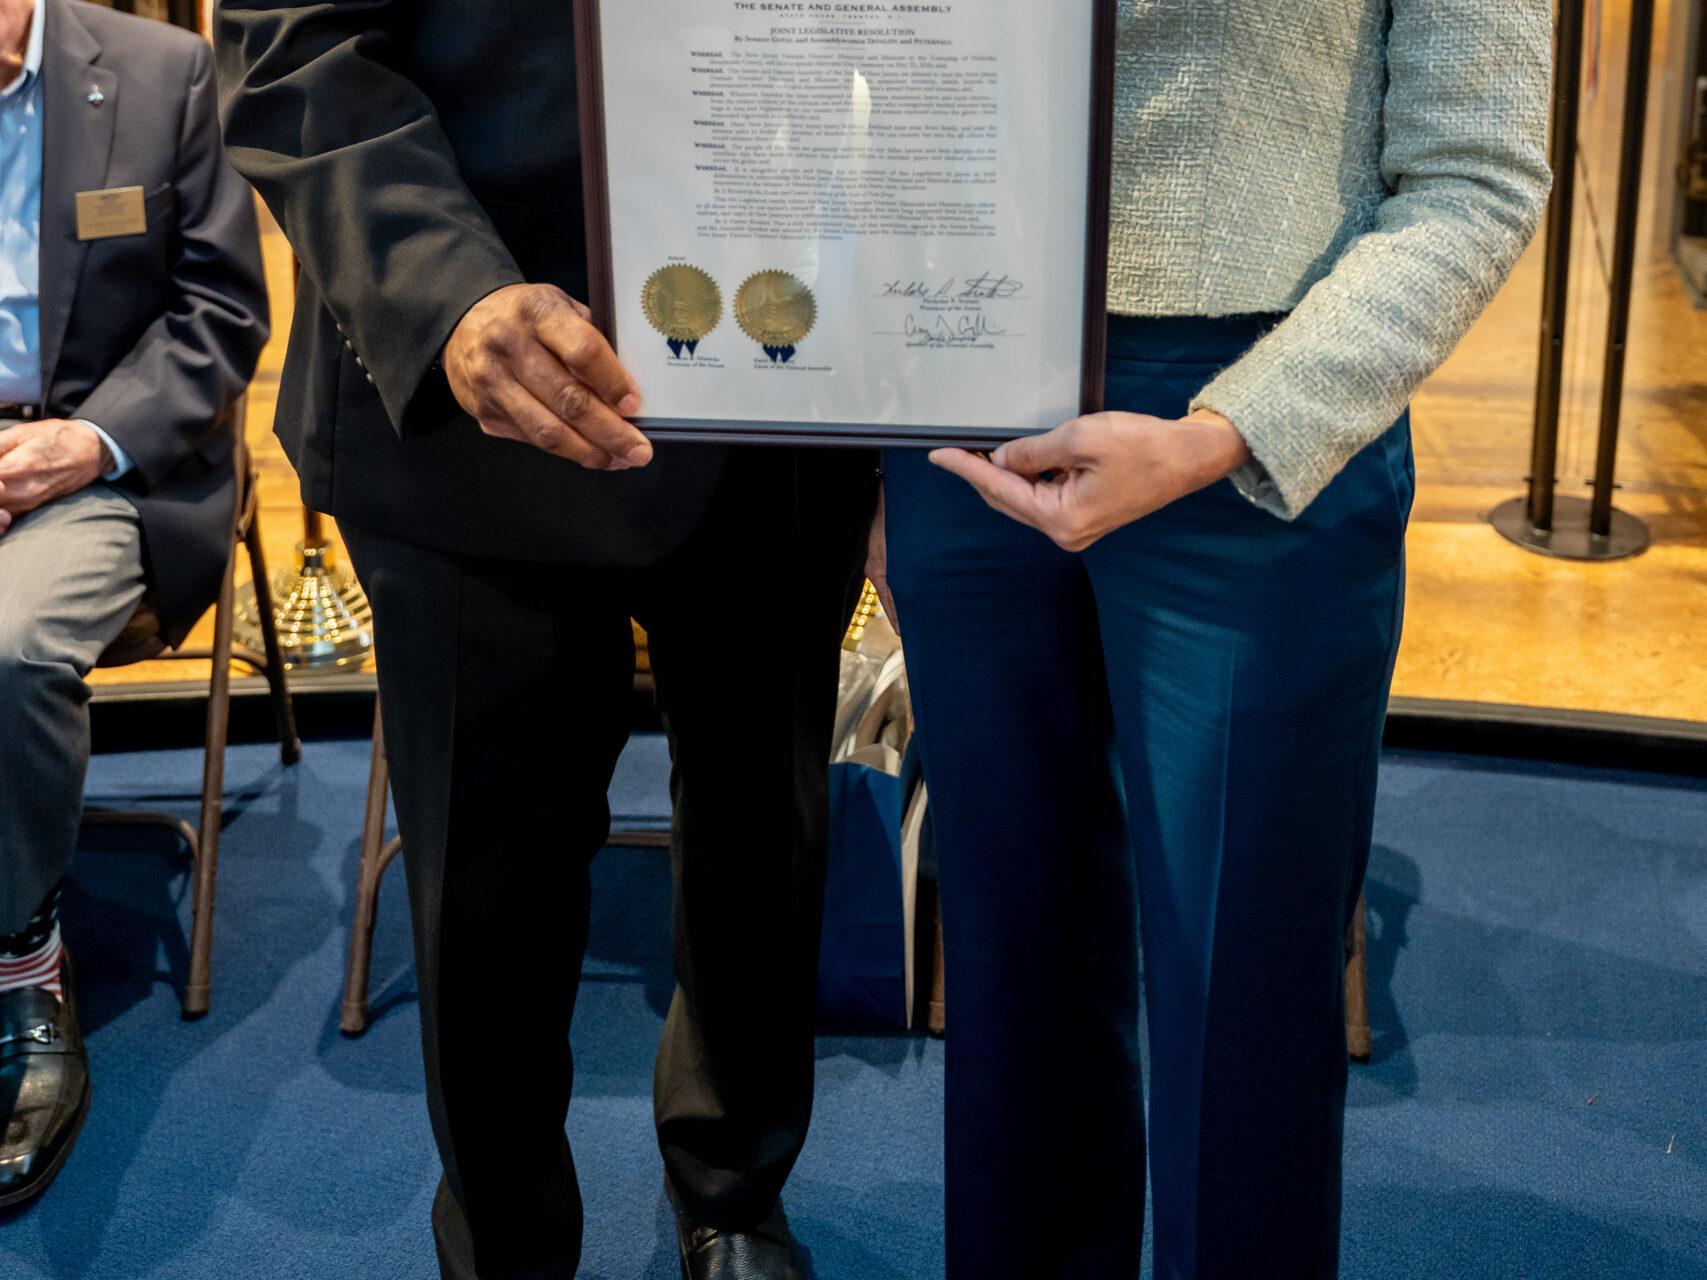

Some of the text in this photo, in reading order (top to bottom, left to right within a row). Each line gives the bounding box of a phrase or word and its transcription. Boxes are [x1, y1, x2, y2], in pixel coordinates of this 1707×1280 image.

[734, 2, 952, 13] THE SENATE AND GENERAL ASSEMBLY
[770, 27, 916, 36] JOINT LEGISLATIVE RESOLUTION
